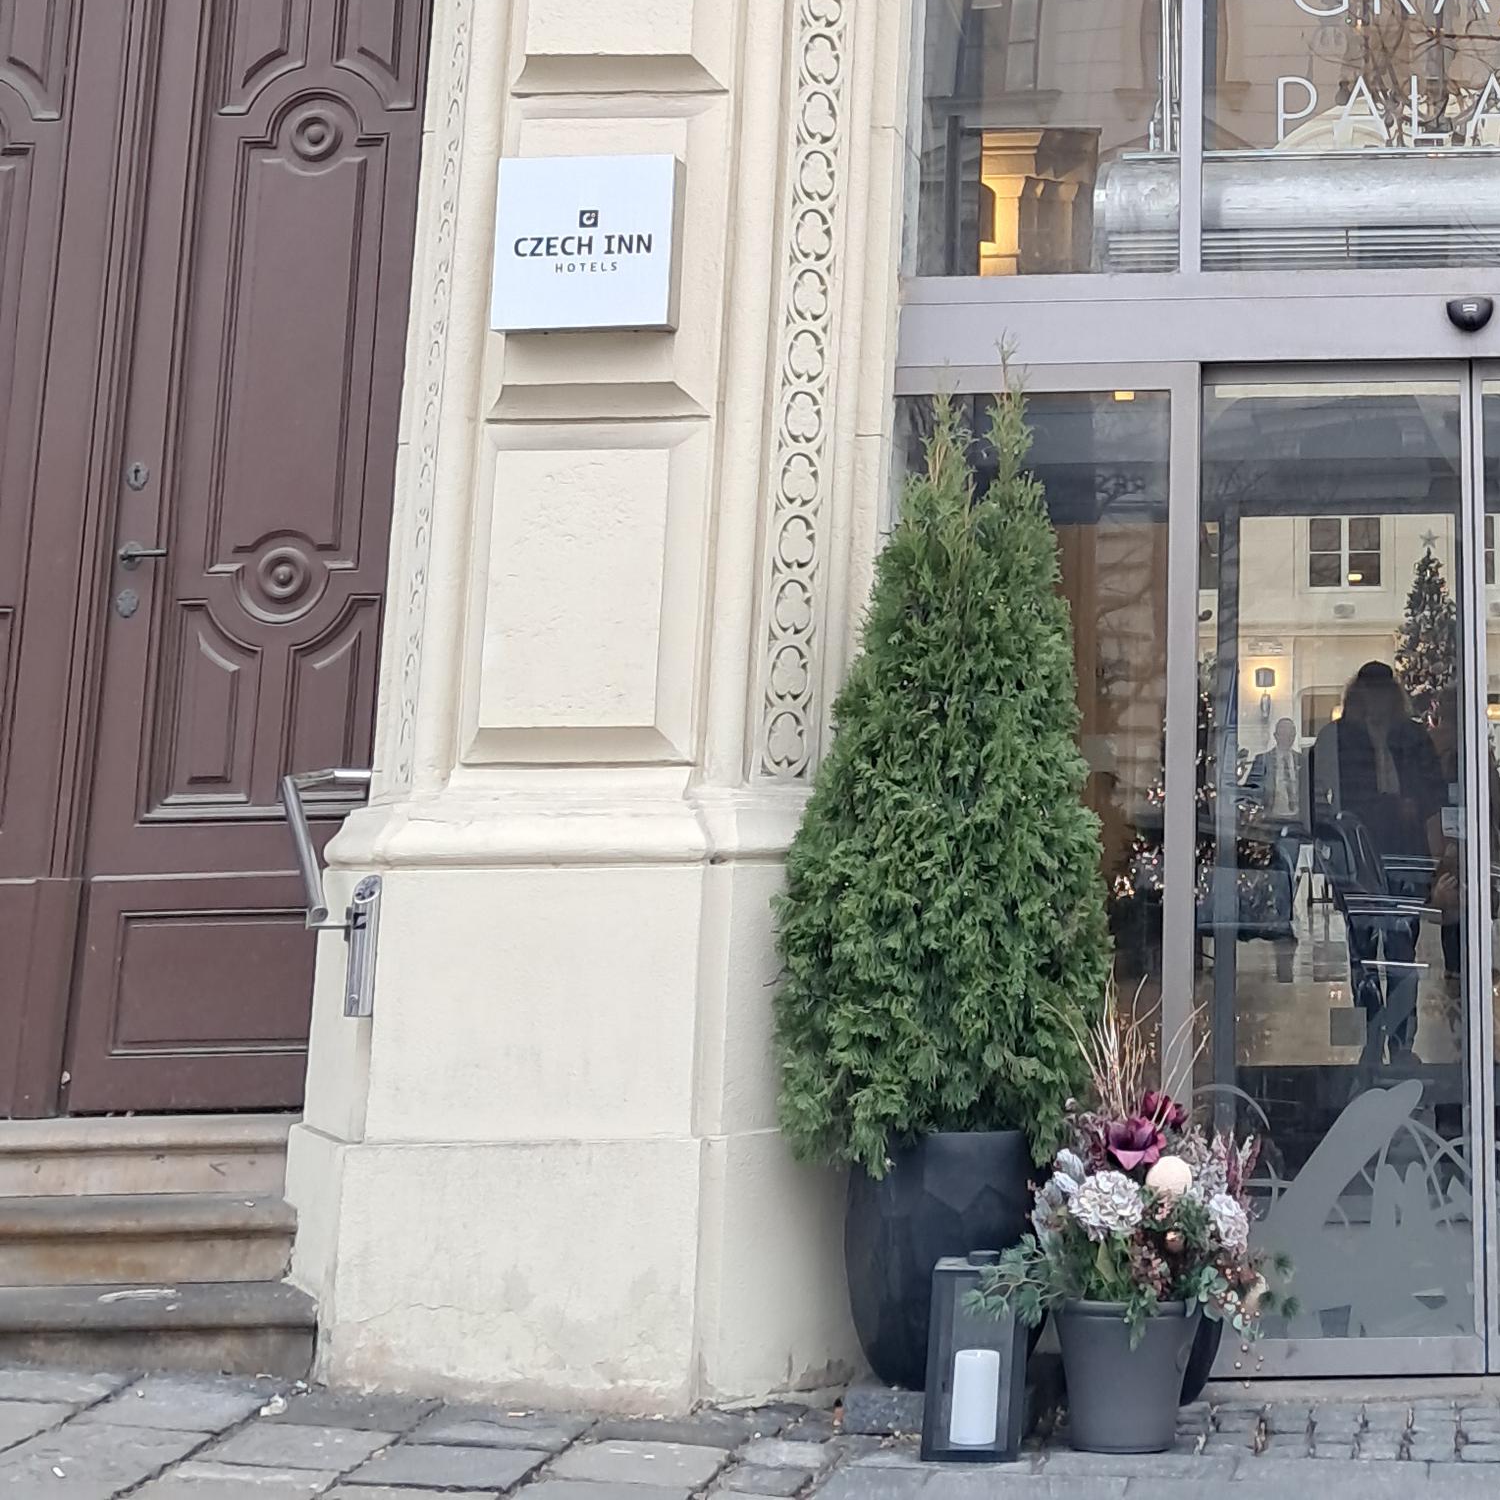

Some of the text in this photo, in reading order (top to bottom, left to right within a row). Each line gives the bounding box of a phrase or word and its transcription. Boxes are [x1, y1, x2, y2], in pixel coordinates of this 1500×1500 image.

[514, 234, 652, 257] CZECH INN
[555, 261, 618, 273] HOTELS
